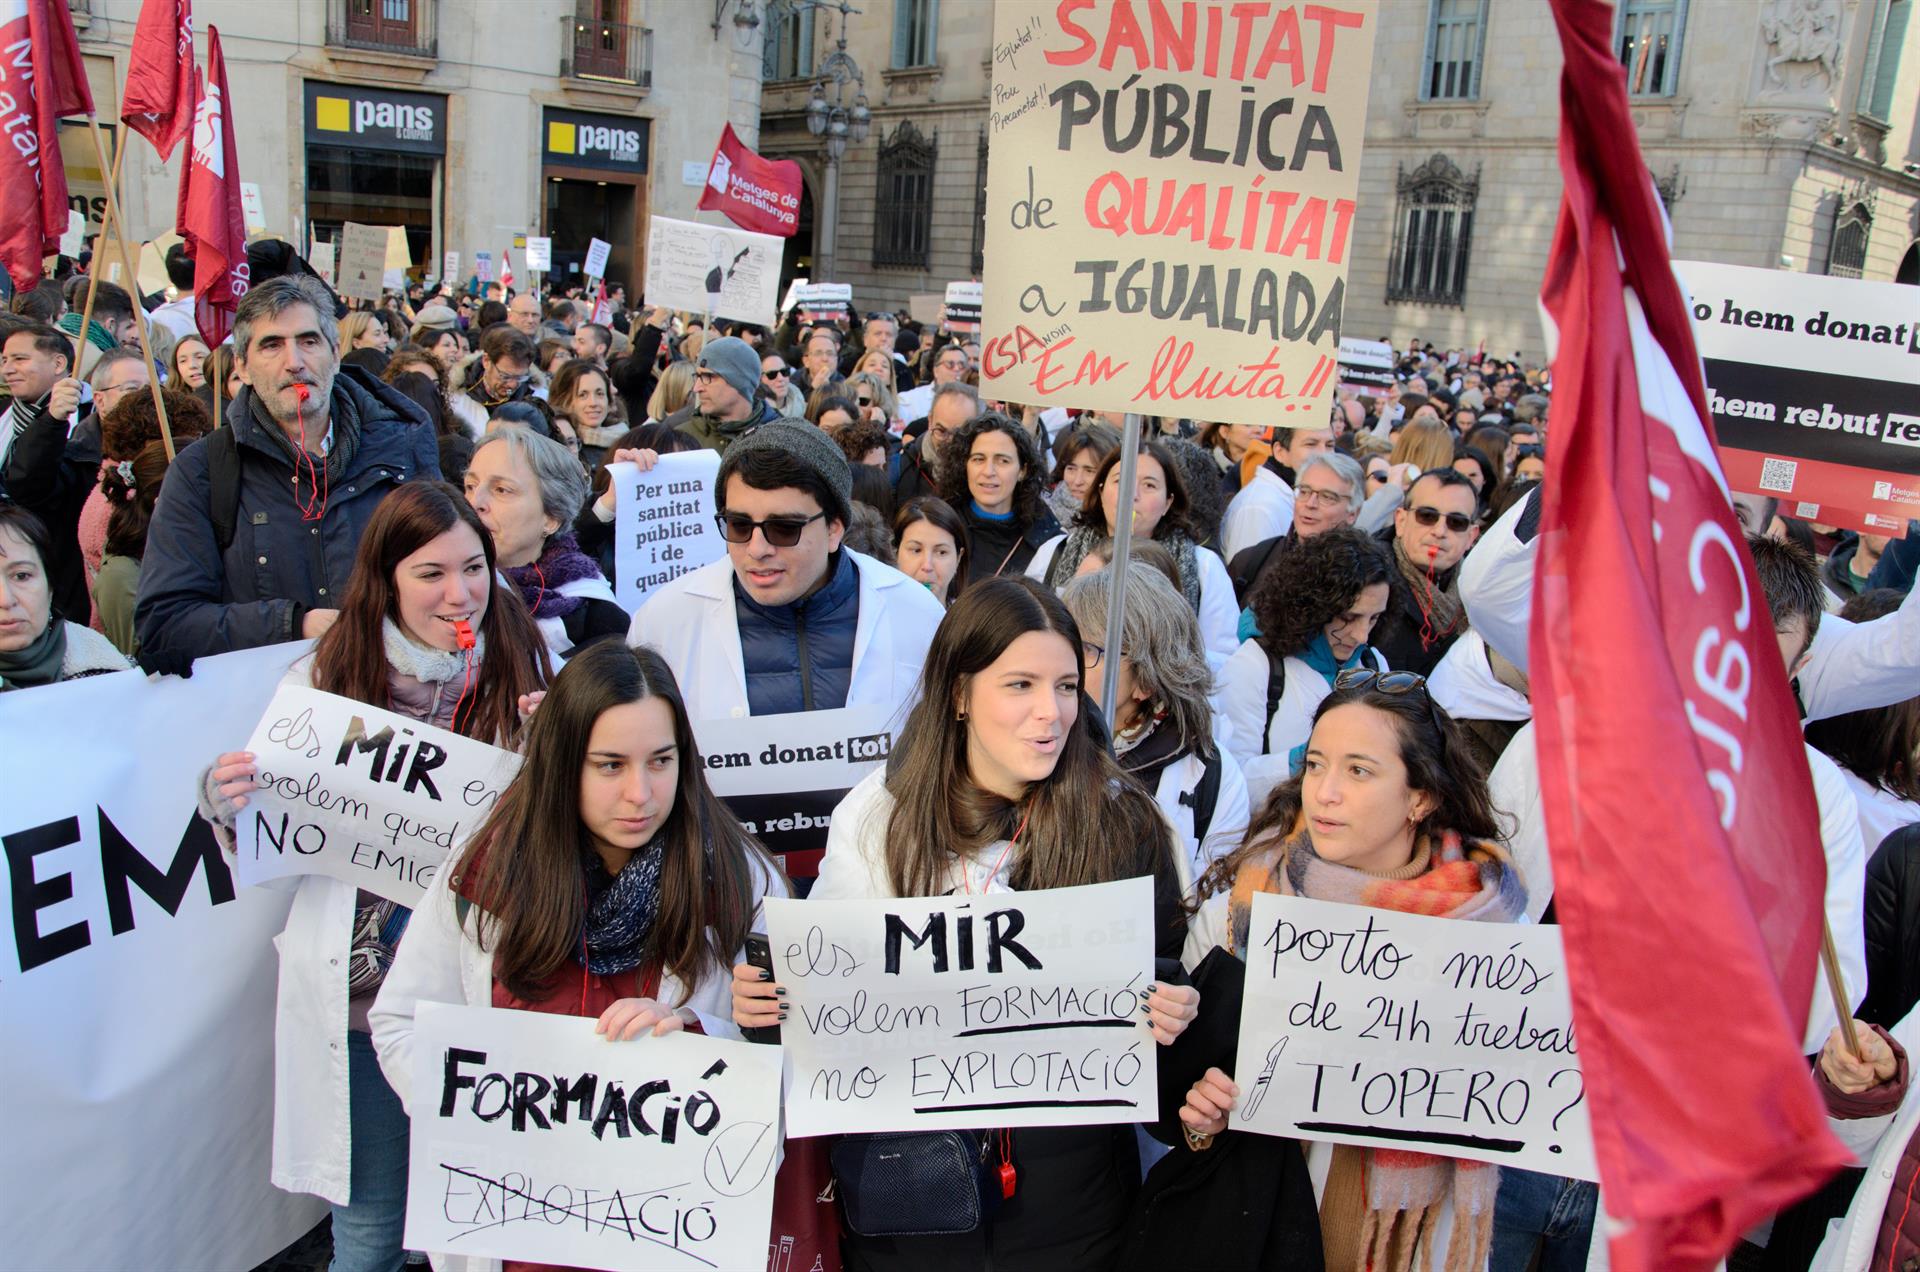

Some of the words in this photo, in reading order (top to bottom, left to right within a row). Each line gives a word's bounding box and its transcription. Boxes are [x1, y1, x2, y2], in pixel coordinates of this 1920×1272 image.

[1043, 0, 1364, 93] SANITAT
[355, 100, 433, 133] pans
[579, 125, 640, 155] pans
[731, 173, 778, 202] Metges
[781, 193, 798, 208] de
[731, 187, 795, 223] Catalunya
[1011, 166, 1056, 230] de
[1019, 283, 1067, 317] a
[1074, 258, 1345, 348] IGUALADA
[1690, 295, 1713, 321] o
[1720, 299, 1794, 333] hem
[1804, 311, 1908, 346] donat
[982, 324, 1047, 380] CSA
[1706, 388, 1776, 421] hem
[1783, 403, 1880, 436] rebut
[636, 484, 662, 500] Per
[668, 480, 703, 495] una
[638, 499, 701, 522] sanitat
[636, 522, 703, 549] pública
[651, 547, 657, 563] i
[661, 544, 684, 561] de
[636, 563, 705, 593] qualit
[268, 708, 322, 758] els
[760, 741, 844, 765] donat
[851, 735, 889, 758] tot
[256, 810, 326, 860] NO
[783, 926, 864, 977] els
[1264, 916, 1413, 981] porto
[1442, 942, 1554, 995] més
[801, 989, 941, 1036] volem
[1289, 981, 1342, 1031] de
[1358, 996, 1430, 1043] 24h
[810, 1066, 886, 1101] no
